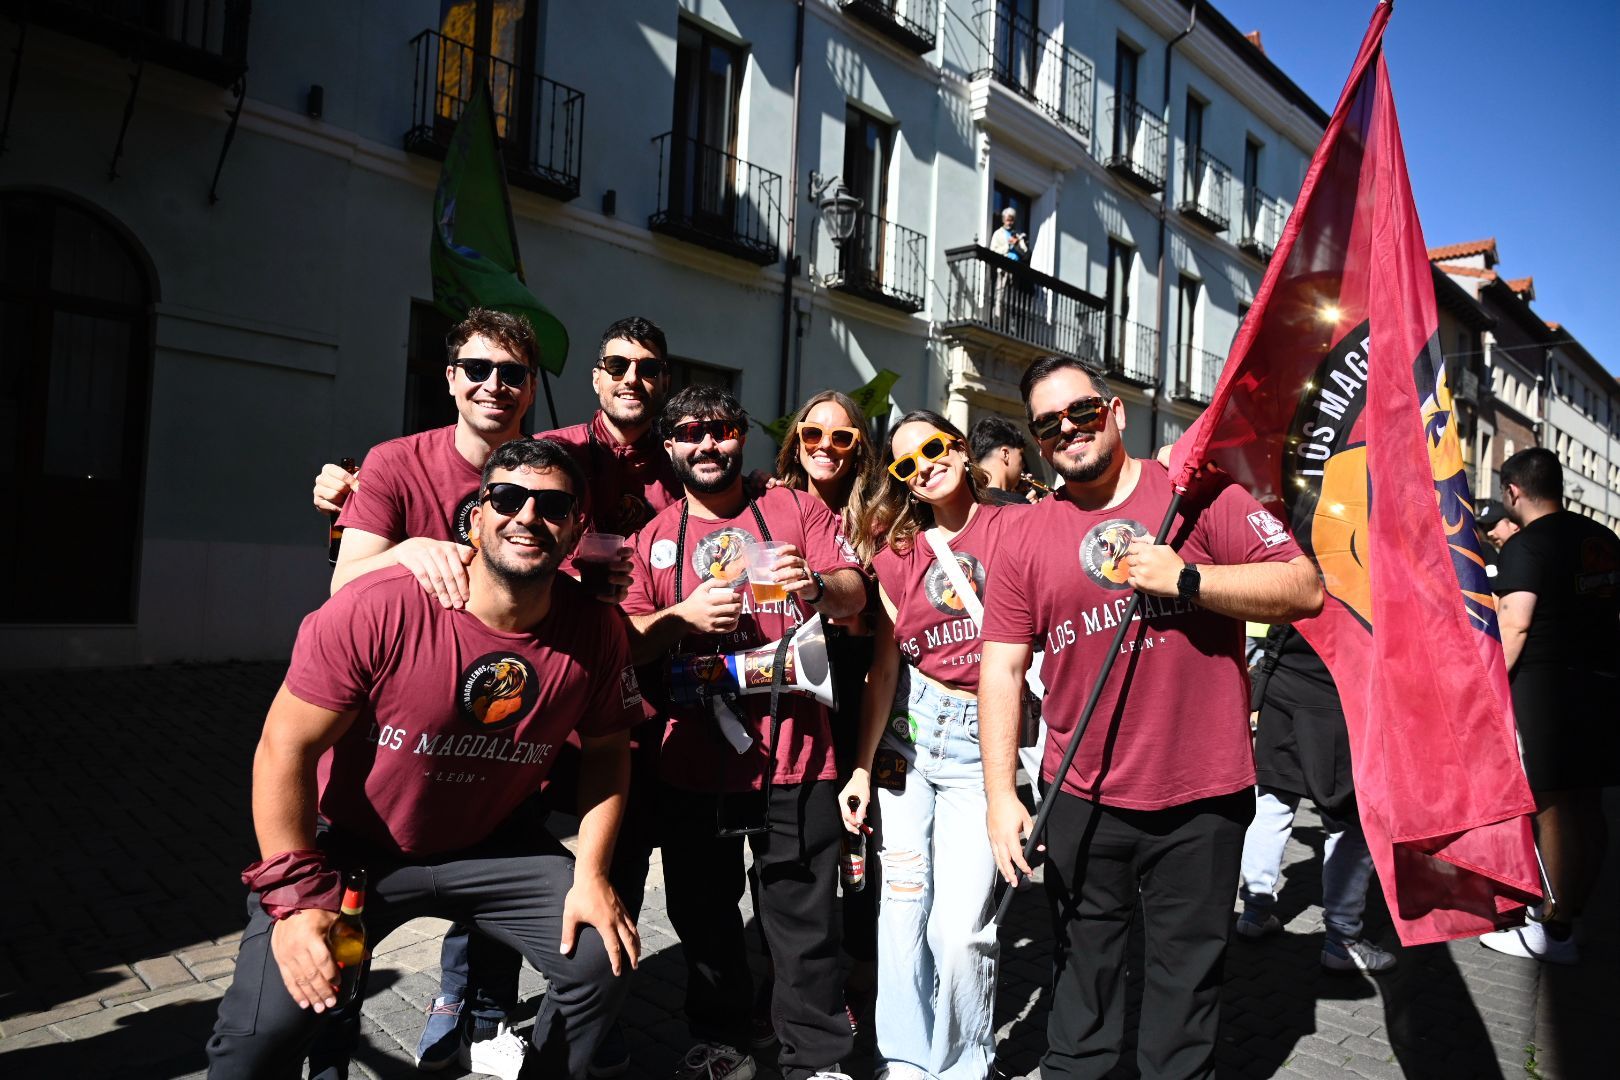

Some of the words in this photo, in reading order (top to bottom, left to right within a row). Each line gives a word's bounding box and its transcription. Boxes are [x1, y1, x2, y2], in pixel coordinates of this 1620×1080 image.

[1048, 620, 1076, 654] LOS
[463, 664, 487, 702] MAGDALENOS
[366, 722, 407, 751] LOS
